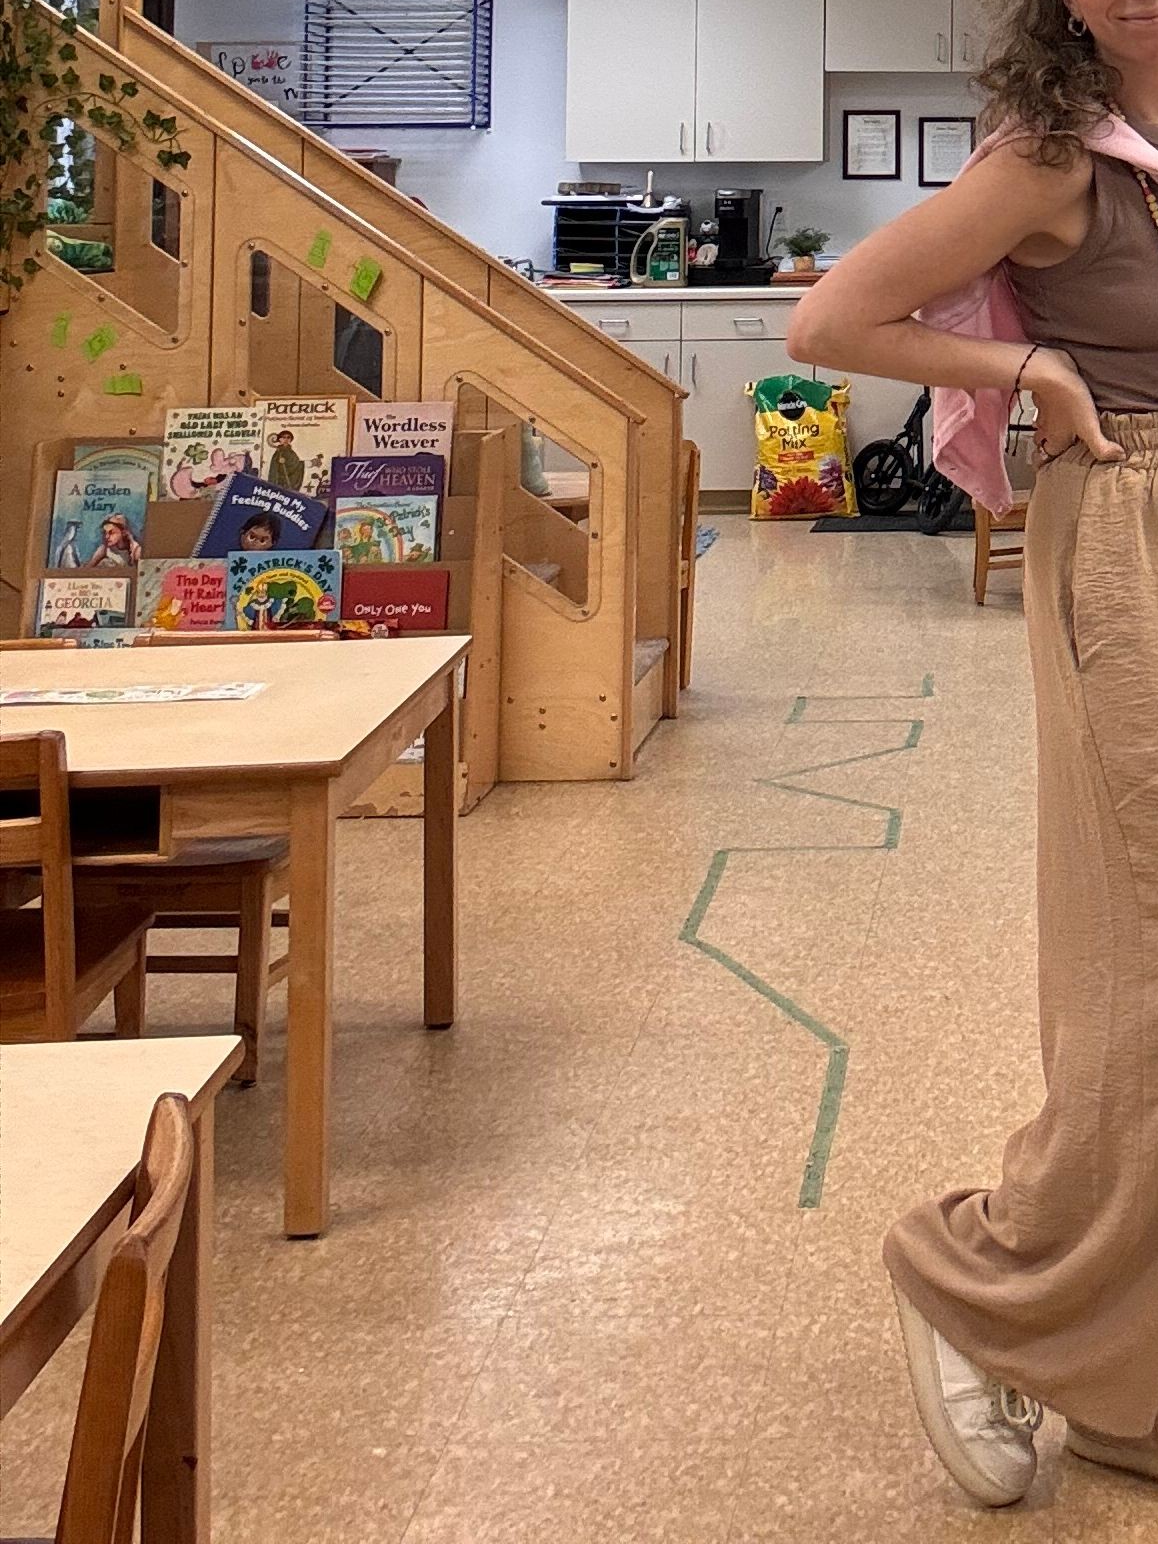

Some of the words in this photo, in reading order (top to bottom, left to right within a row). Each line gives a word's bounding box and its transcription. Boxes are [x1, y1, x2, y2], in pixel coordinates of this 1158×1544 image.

[180, 421, 199, 429] OLD
[200, 421, 224, 429] LADY
[226, 420, 249, 429] WHO
[363, 417, 447, 432] Wordless
[769, 423, 820, 438] Potting
[215, 430, 222, 438] A
[373, 434, 439, 448] Weaver
[782, 437, 806, 451] Mix
[342, 459, 388, 491] Thief
[379, 473, 436, 486] HEAVEN
[69, 483, 82, 496] A
[84, 483, 131, 496] Garden
[83, 499, 117, 512] Mary
[252, 485, 291, 507] Helping
[290, 498, 306, 513] My
[231, 495, 272, 512] Feeling
[272, 501, 312, 531] Buddies
[176, 575, 199, 586] The
[201, 574, 224, 588] Day
[248, 557, 313, 577] PATRICK'S
[313, 571, 333, 592] DAY
[184, 589, 195, 599] It
[196, 588, 226, 599] Rain
[55, 597, 113, 609] GEORGIA
[190, 601, 226, 612] Heart
